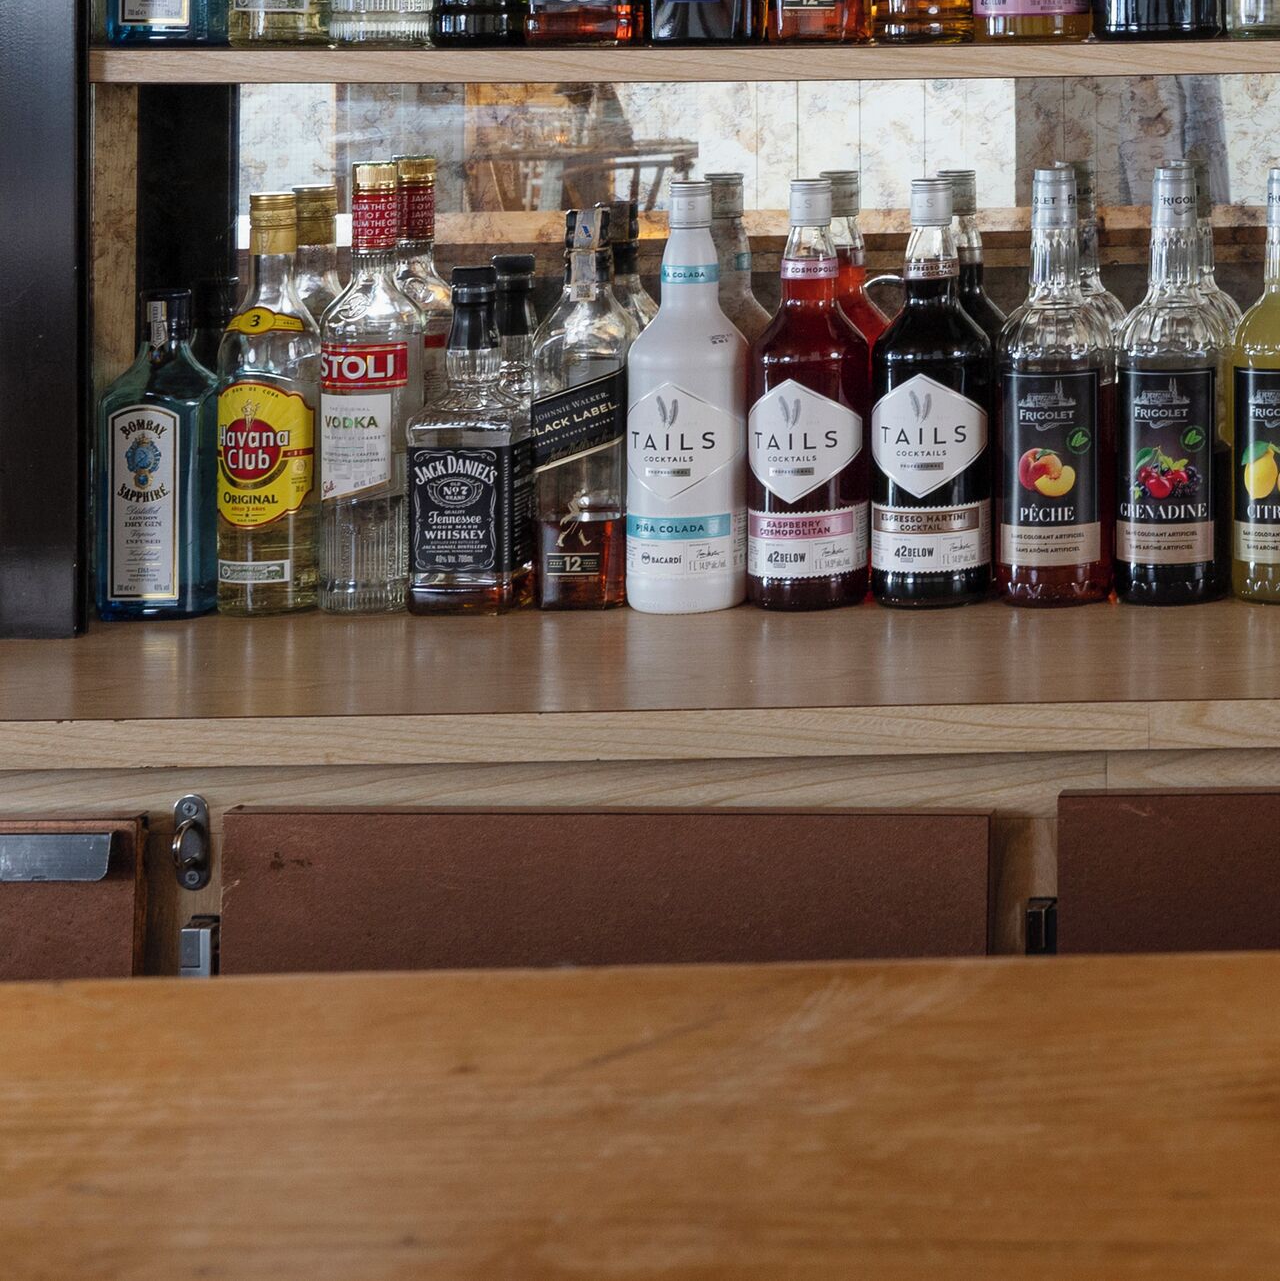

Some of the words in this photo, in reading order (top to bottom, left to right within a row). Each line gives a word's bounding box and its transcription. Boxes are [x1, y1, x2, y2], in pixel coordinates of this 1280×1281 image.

[672, 271, 705, 279] COLADA
[250, 314, 261, 327] 3
[321, 353, 395, 380] STOLI
[535, 404, 571, 425] JOHNNIE
[573, 401, 618, 423] LABEL
[1019, 409, 1075, 421] FRIGOLET
[1134, 406, 1189, 419] FRIGOLET
[324, 415, 379, 429] VODKA
[120, 419, 168, 441] BOMBAY
[219, 424, 290, 448] Havana
[881, 425, 967, 445] TAILS
[631, 431, 717, 452] TAILS
[754, 430, 838, 451] TAILS
[226, 448, 271, 470] Club
[643, 455, 694, 463] COCKTAILS
[414, 460, 448, 486] JACK
[447, 455, 499, 487] DANIEL'S
[116, 482, 170, 503] SAPPHIRE
[223, 491, 279, 505] ORIGINAL
[427, 510, 482, 524] Tennessee
[881, 512, 923, 523] ESPRESSO
[926, 512, 968, 523] MARTINI
[1019, 503, 1075, 522] PÊCHE
[1120, 502, 1208, 520] GRENADINE
[124, 520, 143, 528] DRY
[144, 520, 162, 528] GIN
[635, 521, 657, 534] PIÑA
[659, 522, 705, 534] COLADA
[766, 520, 822, 529] RASPBERRY
[899, 524, 943, 532] COCKTAIL
[424, 530, 486, 540] WHISKEY
[760, 527, 831, 537] COSMOPOLITAN
[1023, 532, 1054, 540] COLORANT
[1054, 532, 1085, 540] ARTIFICIEL
[1137, 530, 1167, 538] COLORANT
[1167, 530, 1198, 538] ARTIFICIEL
[1050, 546, 1080, 554] ARTIFICIEL
[1162, 543, 1193, 551] ARTIFICIEL
[563, 556, 582, 572] 12
[651, 554, 682, 565] BACARDÍ
